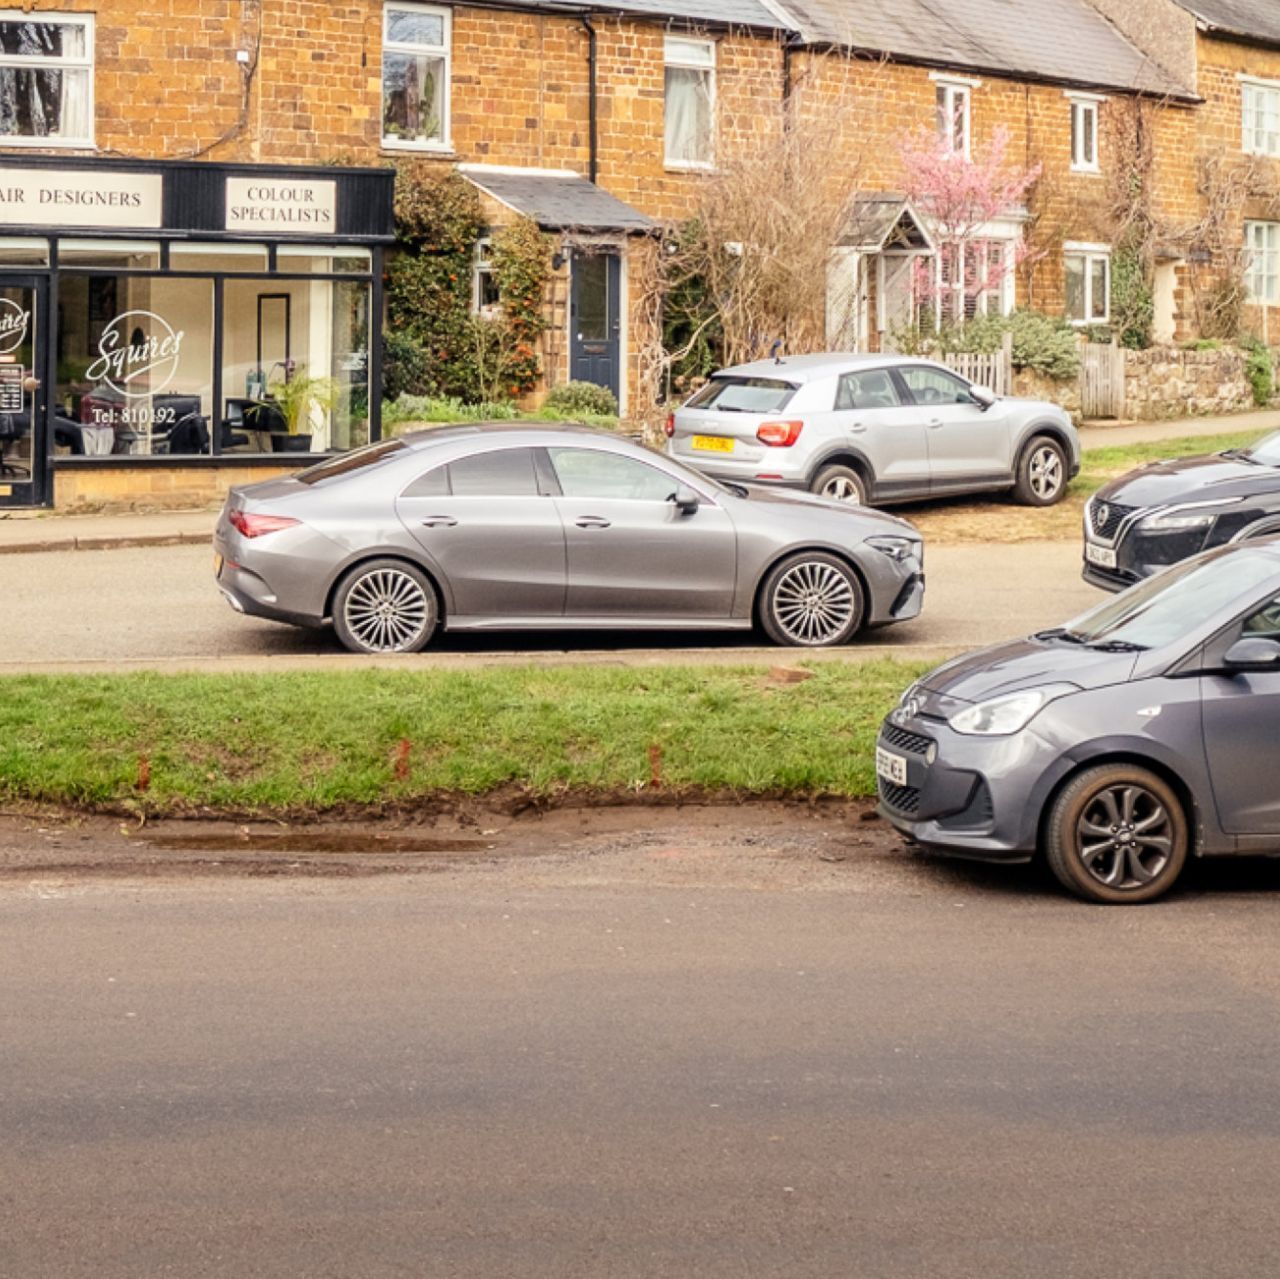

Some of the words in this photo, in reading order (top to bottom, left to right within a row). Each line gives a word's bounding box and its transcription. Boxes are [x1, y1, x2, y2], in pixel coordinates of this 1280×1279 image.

[39, 189, 141, 207] DESIGNERS
[247, 186, 313, 202] COLOUR
[231, 206, 330, 222] SPECIALISTS
[85, 330, 185, 381] Squires
[92, 409, 118, 423] Tel:
[122, 407, 176, 423] 810192
